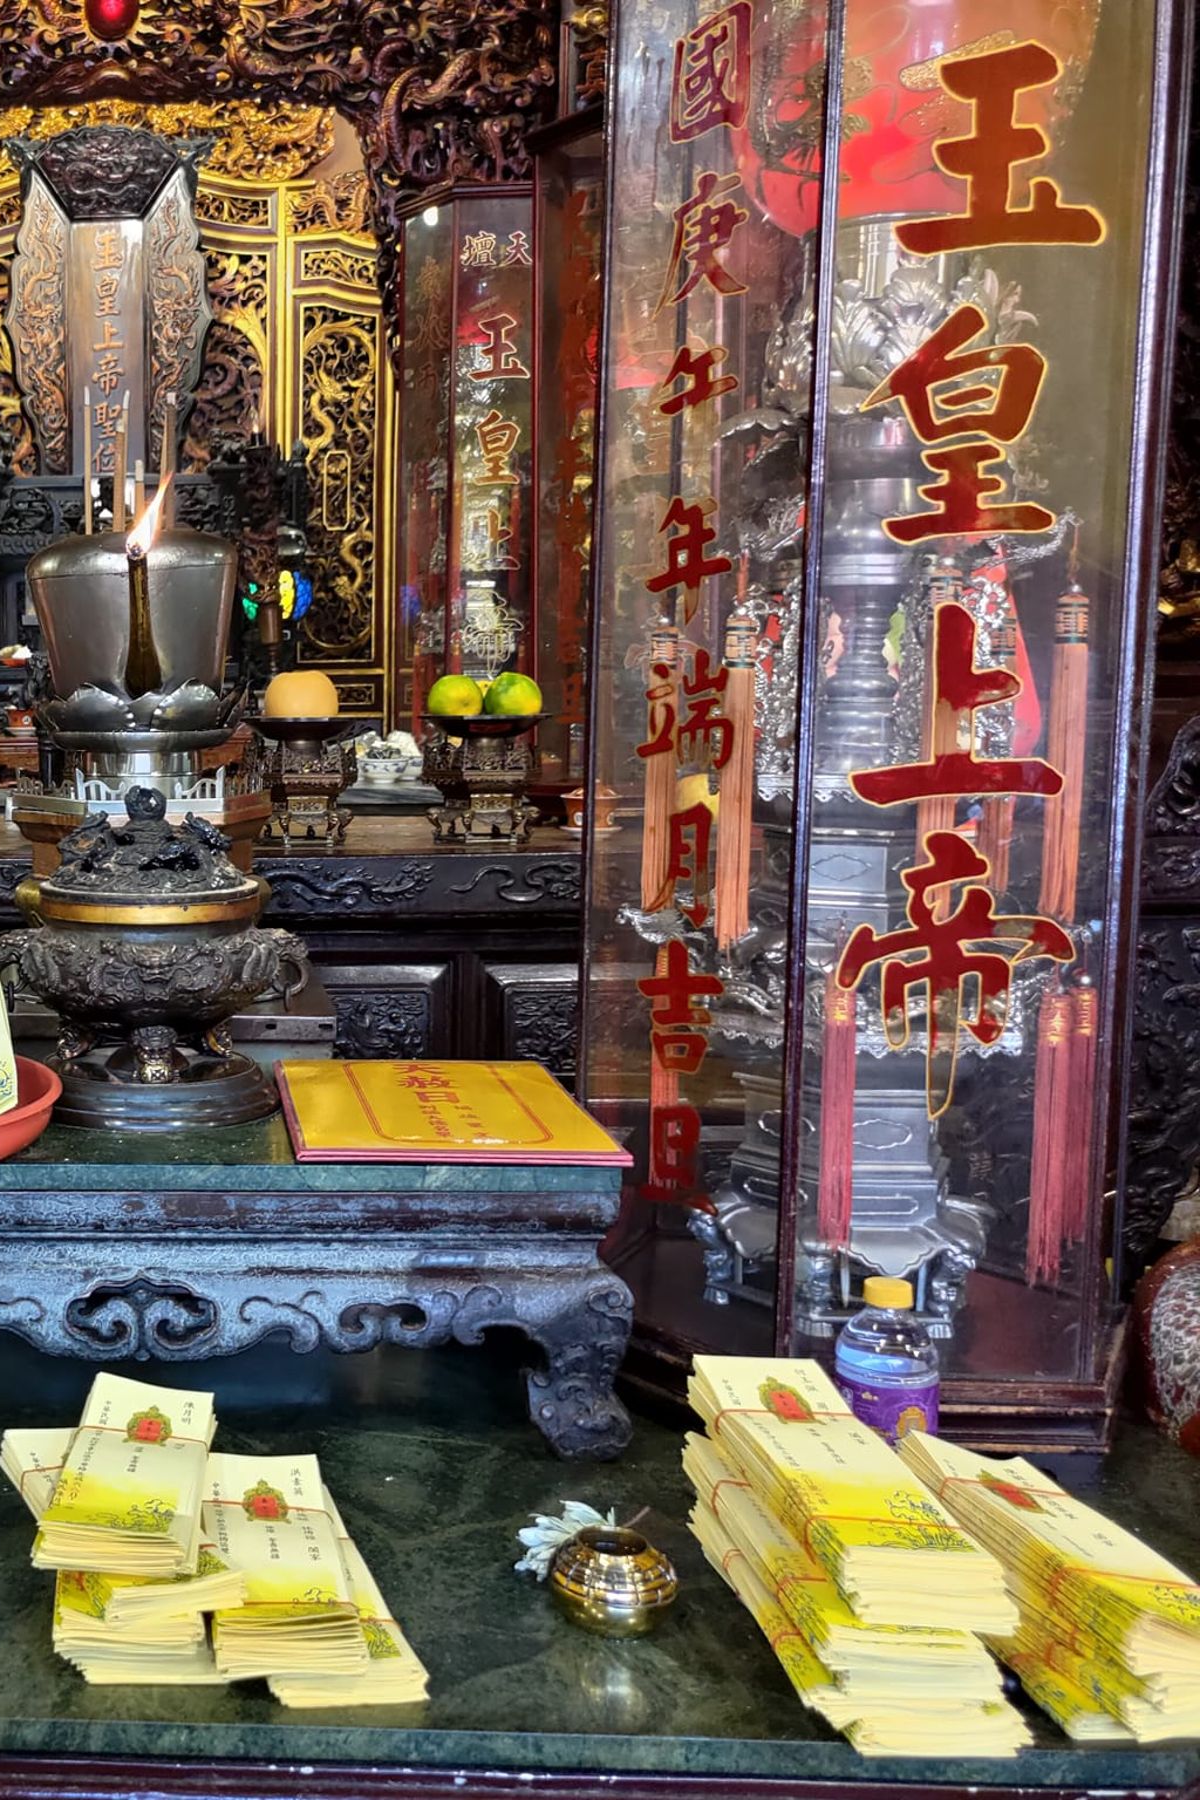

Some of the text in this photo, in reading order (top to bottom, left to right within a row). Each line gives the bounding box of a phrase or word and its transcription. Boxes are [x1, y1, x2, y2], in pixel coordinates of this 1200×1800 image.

[460, 229, 533, 267] 天壇
[463, 312, 531, 680] 玉皇上帝
[836, 39, 1106, 1121] 玉皇上帝
